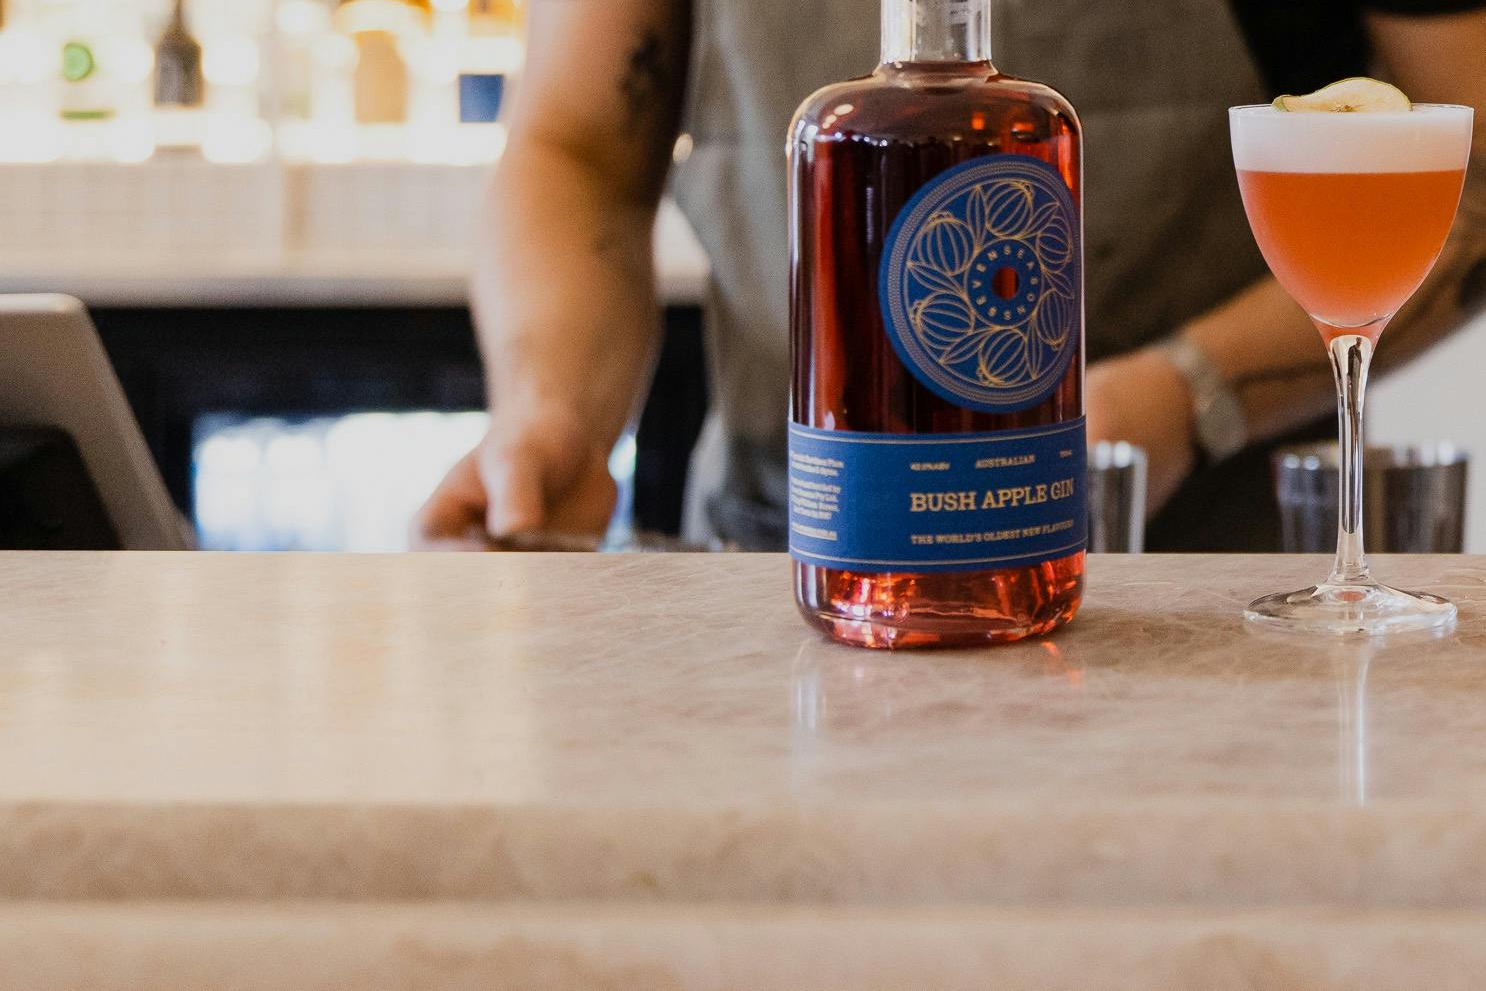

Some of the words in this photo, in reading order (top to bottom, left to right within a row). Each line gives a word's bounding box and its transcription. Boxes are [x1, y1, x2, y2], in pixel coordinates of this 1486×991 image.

[976, 455, 1035, 469] AUSTRALIAN
[910, 492, 976, 511] BUSH
[982, 484, 1047, 509] APPLE
[1050, 478, 1073, 500] GIN
[911, 534, 934, 545] THE
[936, 532, 982, 545] WORLD'S
[983, 528, 1021, 542] OLDEST
